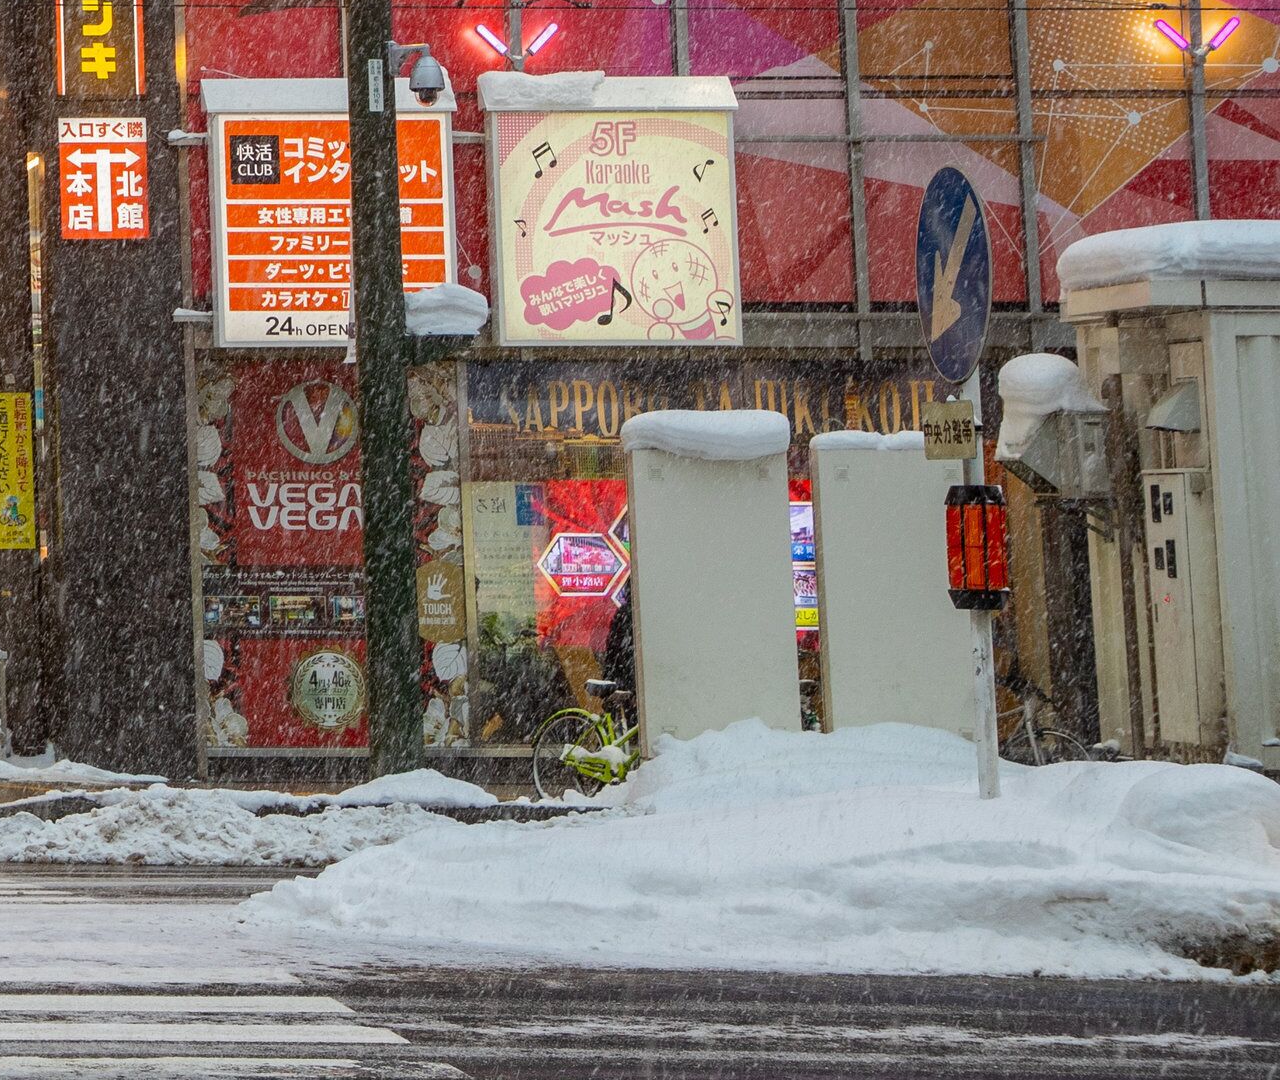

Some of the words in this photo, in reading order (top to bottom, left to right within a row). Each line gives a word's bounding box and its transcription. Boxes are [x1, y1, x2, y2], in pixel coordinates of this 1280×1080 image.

[61, 121, 143, 138] 入口すぐ隣
[589, 120, 637, 157] 5F
[236, 143, 273, 161] 快活
[283, 136, 350, 160] コミッ
[237, 163, 273, 177] CLUB
[585, 160, 651, 185] Karaoke
[66, 170, 94, 231] 本店
[115, 170, 144, 230] 北館
[543, 185, 688, 232] Mash
[589, 231, 655, 247] マッシュ
[528, 268, 608, 307] みんなで楽しく
[538, 283, 609, 317] 歌いマッシュ
[305, 324, 349, 336] OPEN
[13, 397, 30, 493] 自転車から降りて
[246, 470, 334, 481] PACHINKO
[246, 482, 362, 508] VEGA
[247, 505, 363, 531] VEGA
[423, 602, 452, 615] TOUCH
